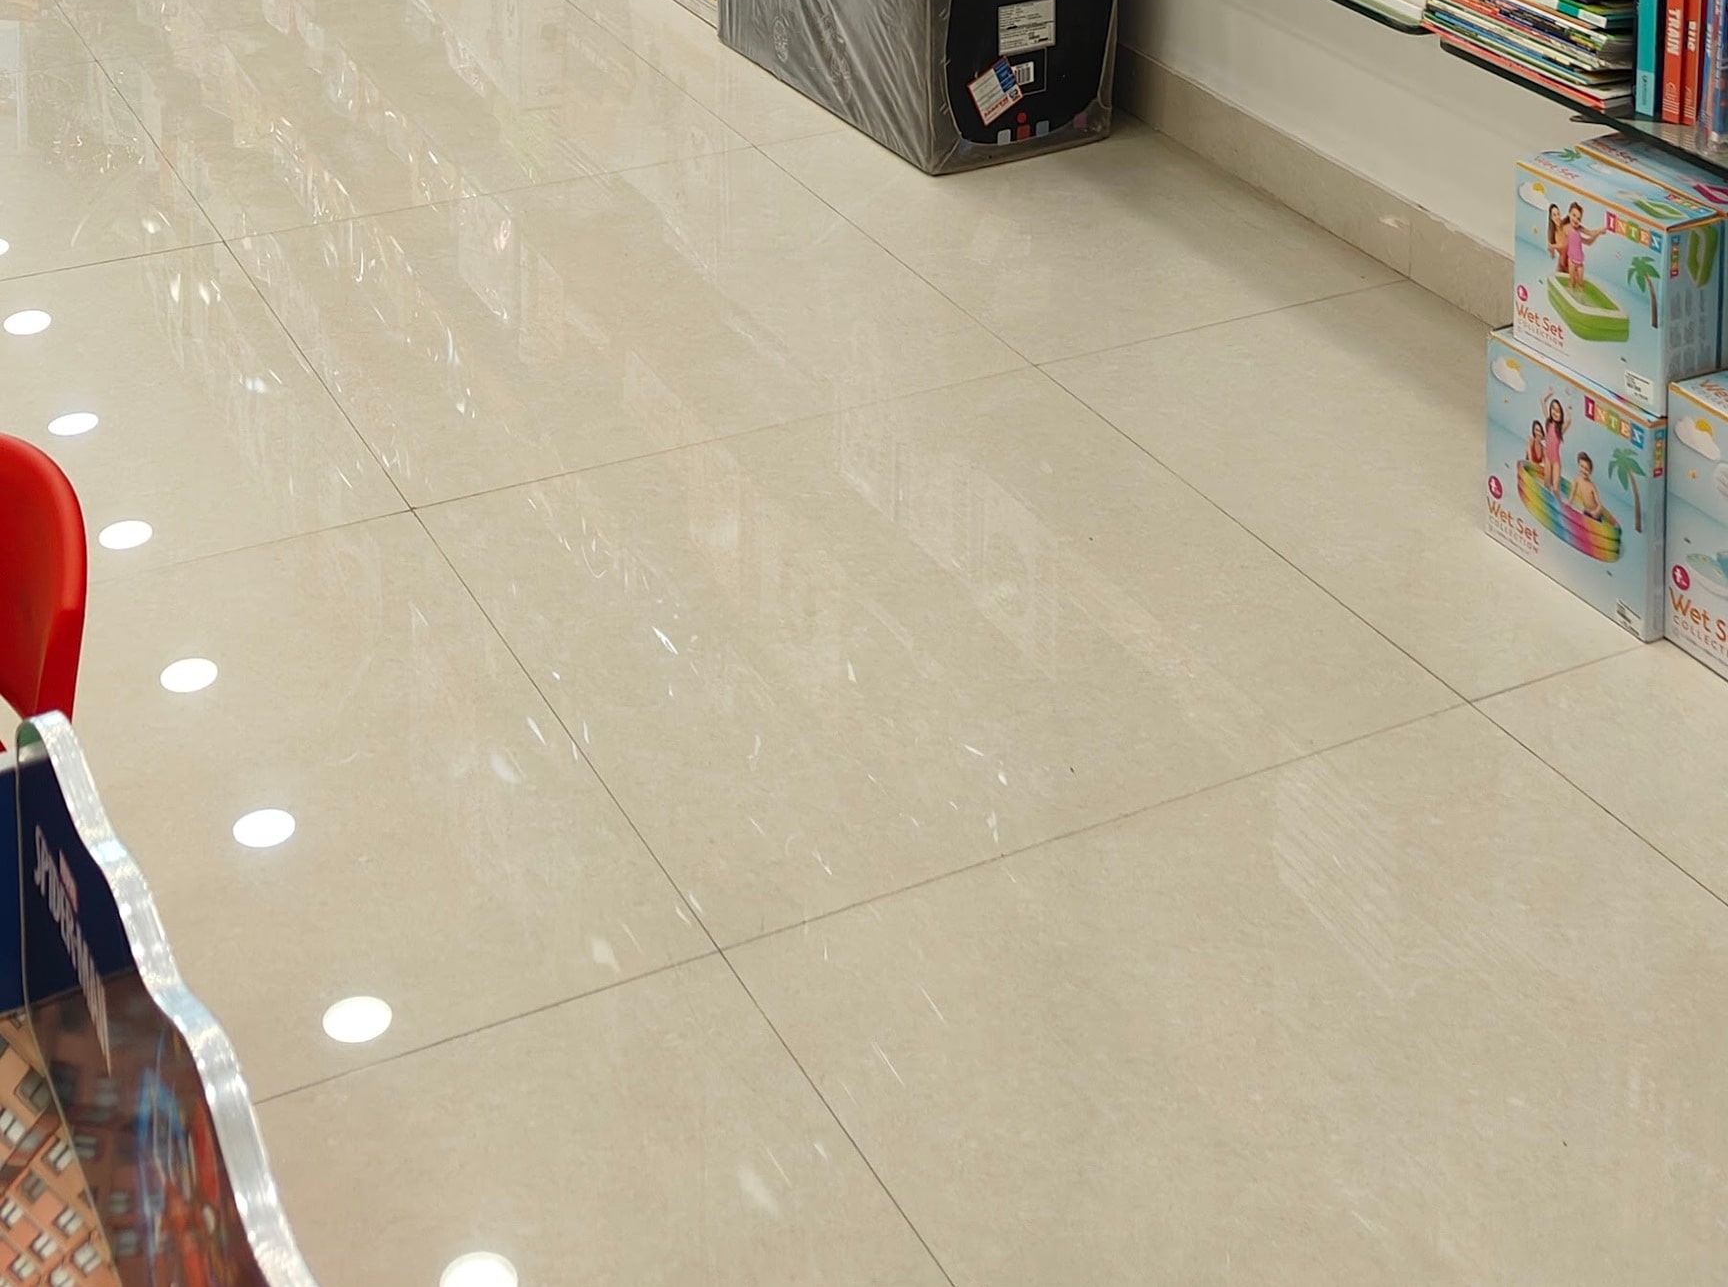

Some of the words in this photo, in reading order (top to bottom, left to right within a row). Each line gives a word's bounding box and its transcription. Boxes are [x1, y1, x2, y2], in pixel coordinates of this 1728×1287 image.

[1665, 8, 1682, 56] TRAIN
[1557, 168, 1580, 180] Set
[1616, 150, 1638, 163] Set
[1607, 212, 1662, 250] INTEX
[1515, 303, 1541, 328] Wet
[1541, 316, 1564, 339] Set
[1585, 396, 1644, 448] INTEX
[1486, 496, 1514, 528] Wet
[1515, 517, 1540, 546] Set
[1488, 514, 1539, 554] COLLECTION
[1669, 586, 1711, 628] Wet
